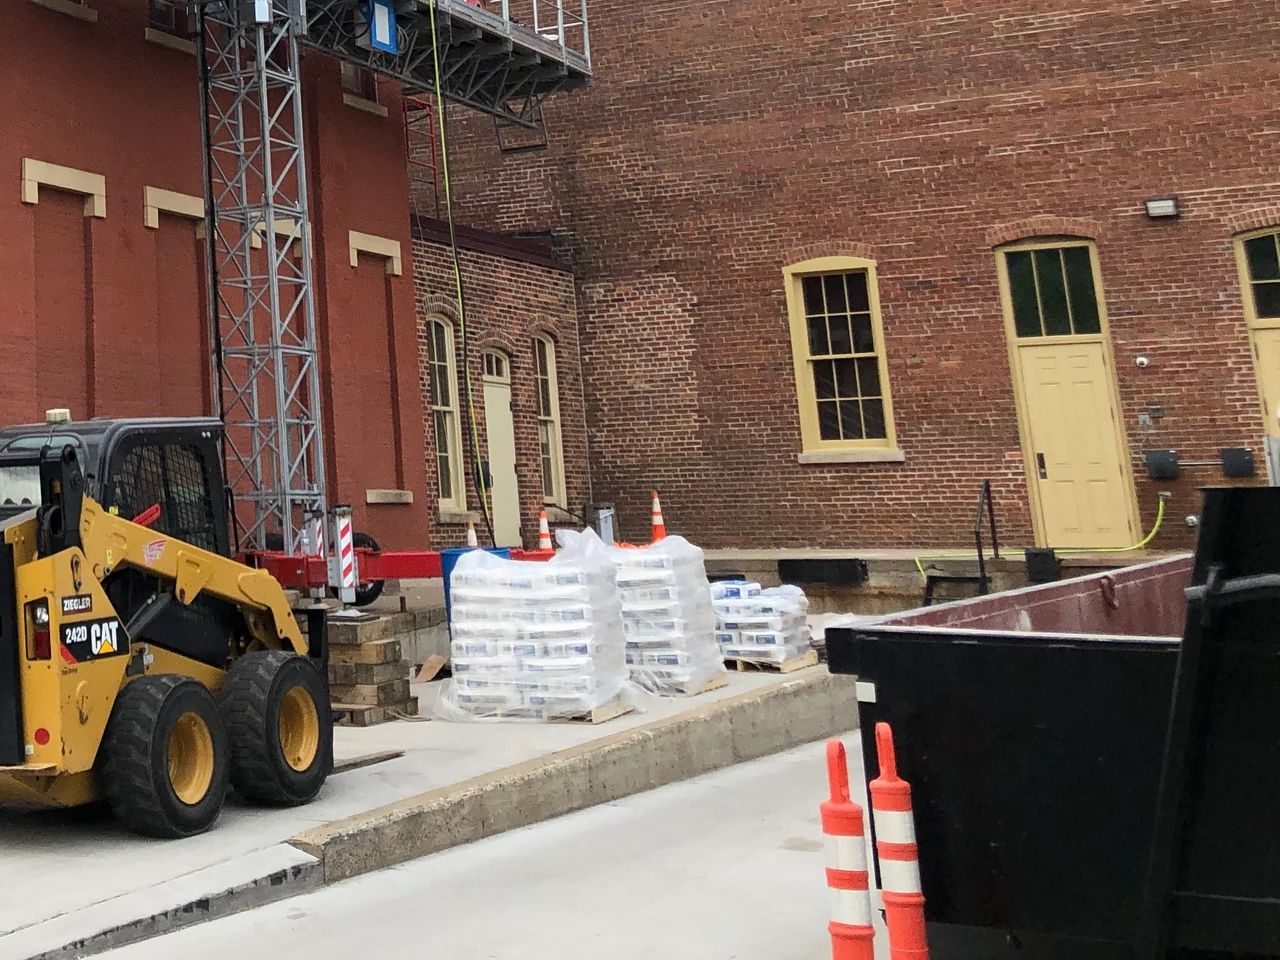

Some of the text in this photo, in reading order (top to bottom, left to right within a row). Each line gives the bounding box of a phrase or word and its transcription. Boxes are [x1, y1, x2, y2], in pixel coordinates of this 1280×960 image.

[63, 597, 91, 612] ZIEGLER
[65, 621, 119, 655] 242D CAT
